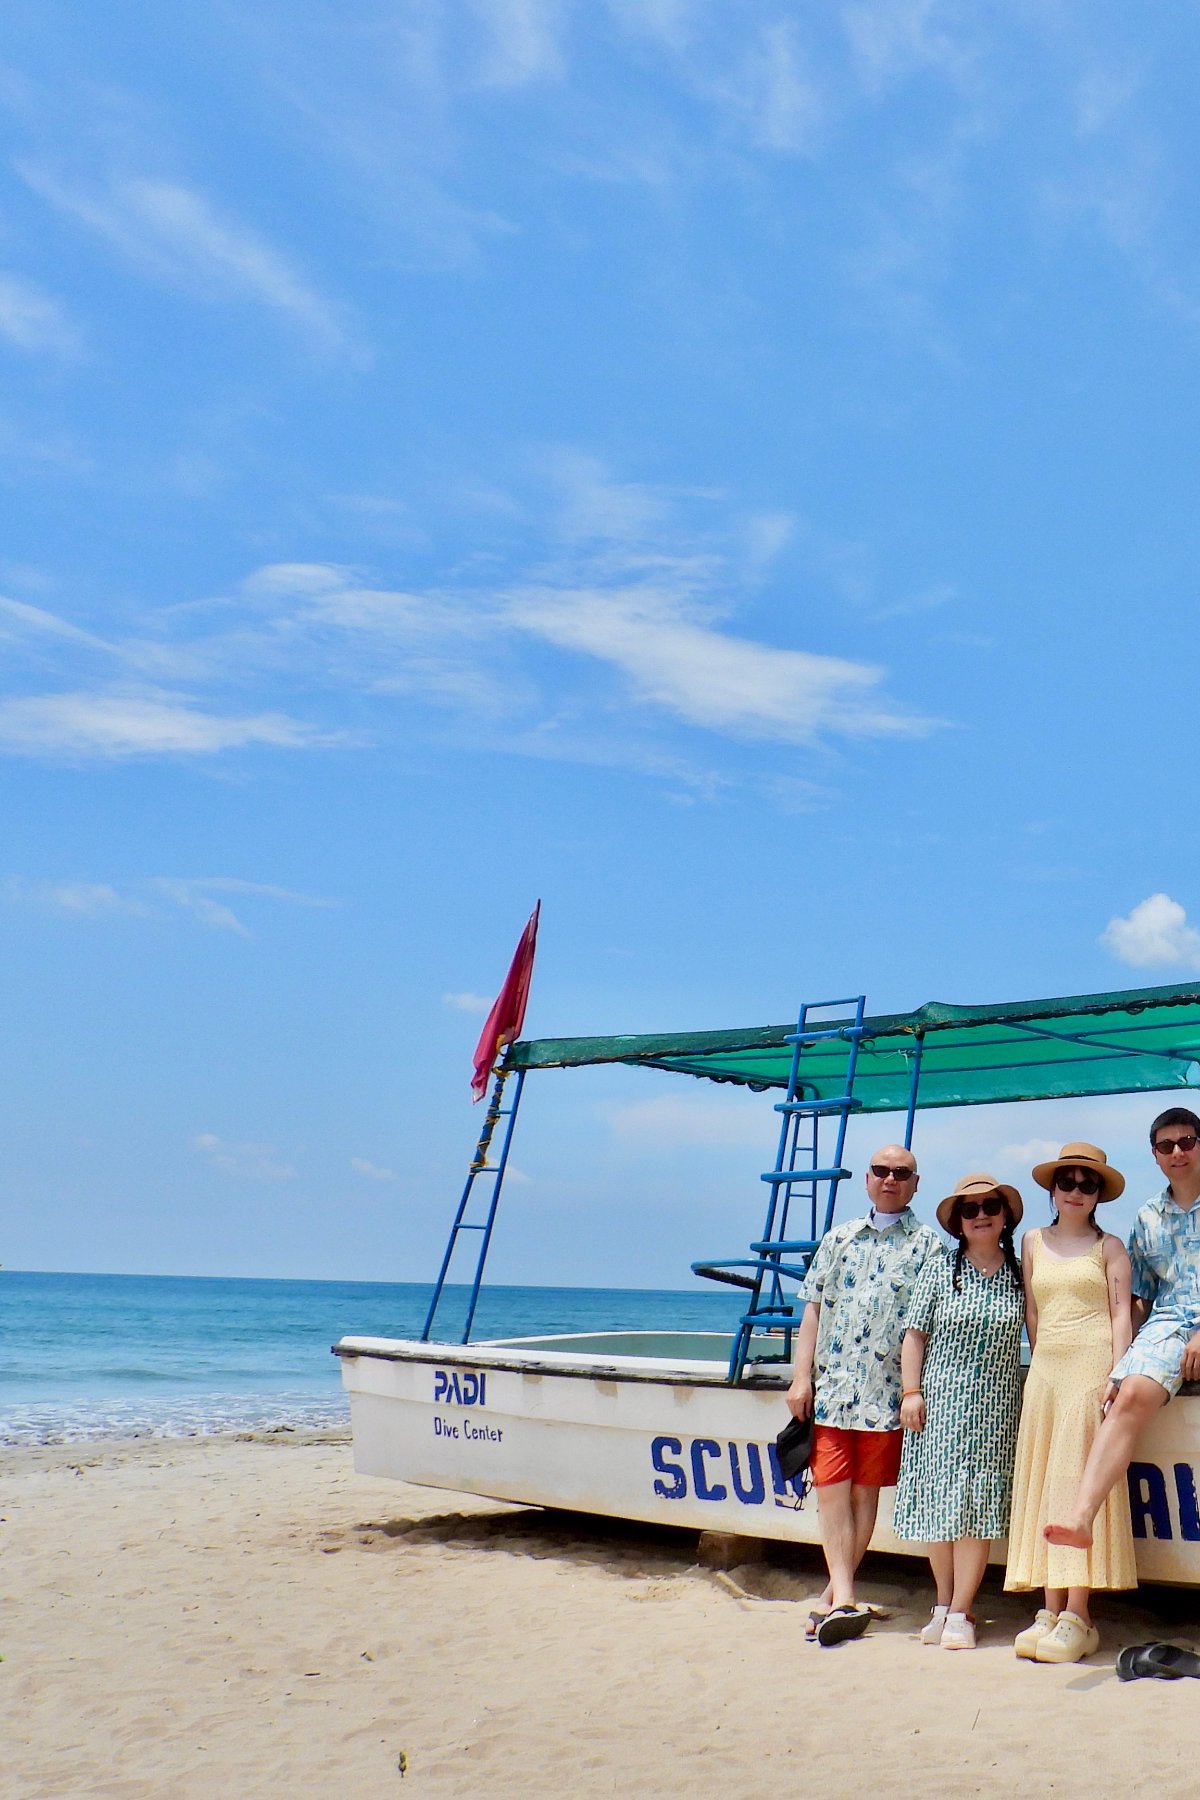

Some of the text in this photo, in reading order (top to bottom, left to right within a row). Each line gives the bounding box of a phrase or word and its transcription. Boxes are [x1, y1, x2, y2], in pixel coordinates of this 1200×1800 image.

[434, 1370, 486, 1406] PADI
[434, 1417, 503, 1442] Dive Center
